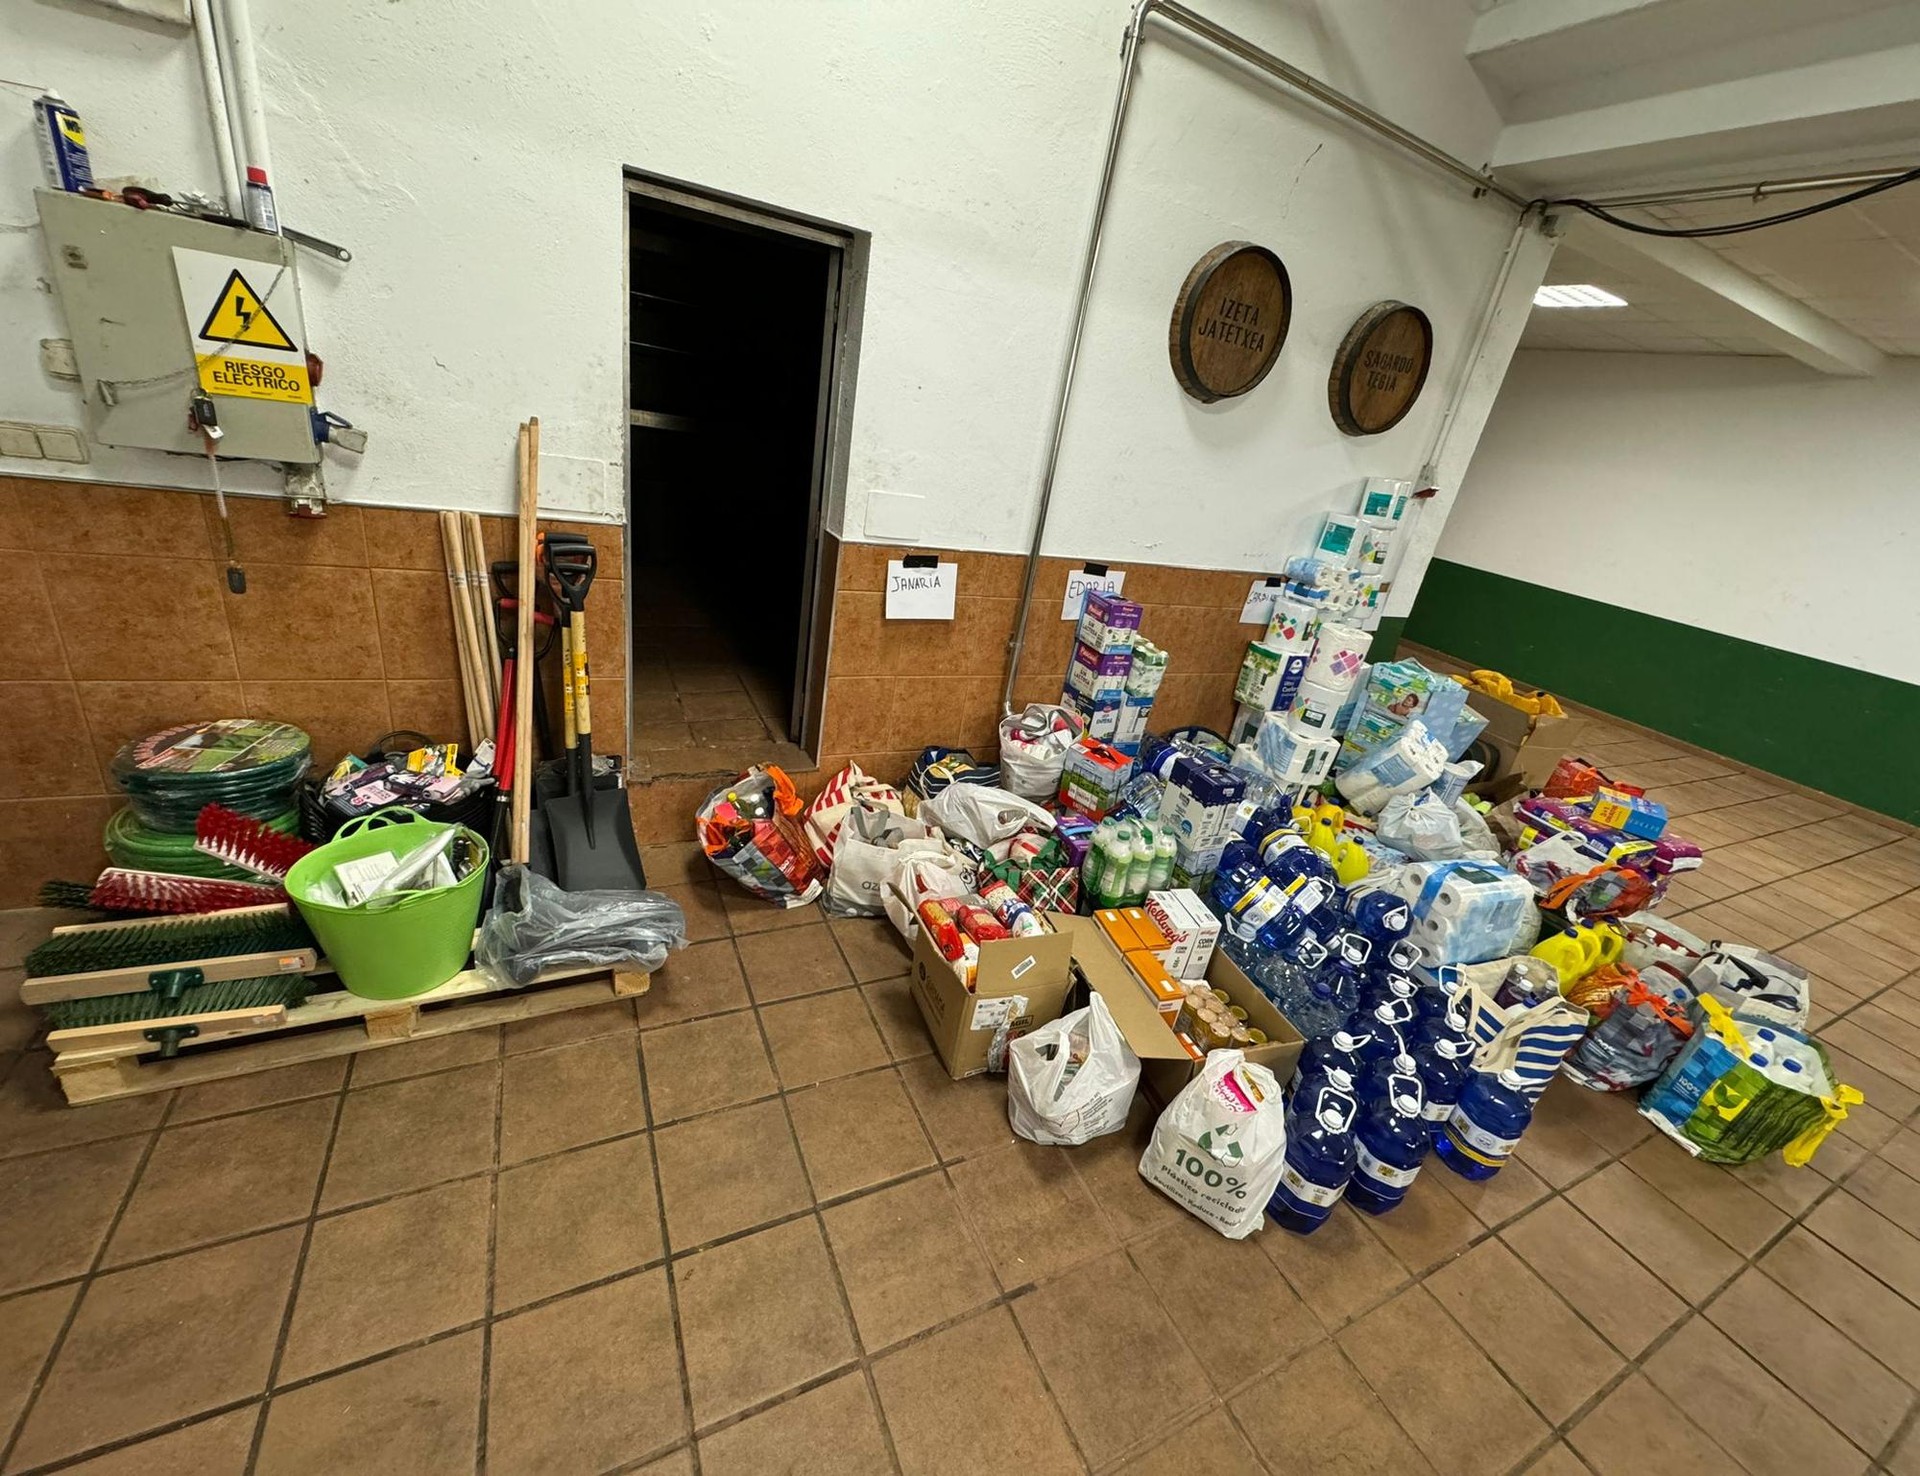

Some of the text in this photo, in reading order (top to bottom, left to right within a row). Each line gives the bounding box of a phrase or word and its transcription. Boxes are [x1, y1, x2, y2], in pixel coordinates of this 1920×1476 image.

[1219, 297, 1260, 326] IZETA
[1198, 317, 1265, 353] JATETXEA
[224, 360, 286, 379] RIESGO
[1364, 350, 1414, 374] SAGARDO
[212, 370, 300, 392] ELECTRICO
[1366, 370, 1398, 392] TEGIA
[1145, 898, 1189, 945] Kellogg's
[1679, 1075, 1701, 1097] 100%
[1175, 1149, 1247, 1200] 100%
